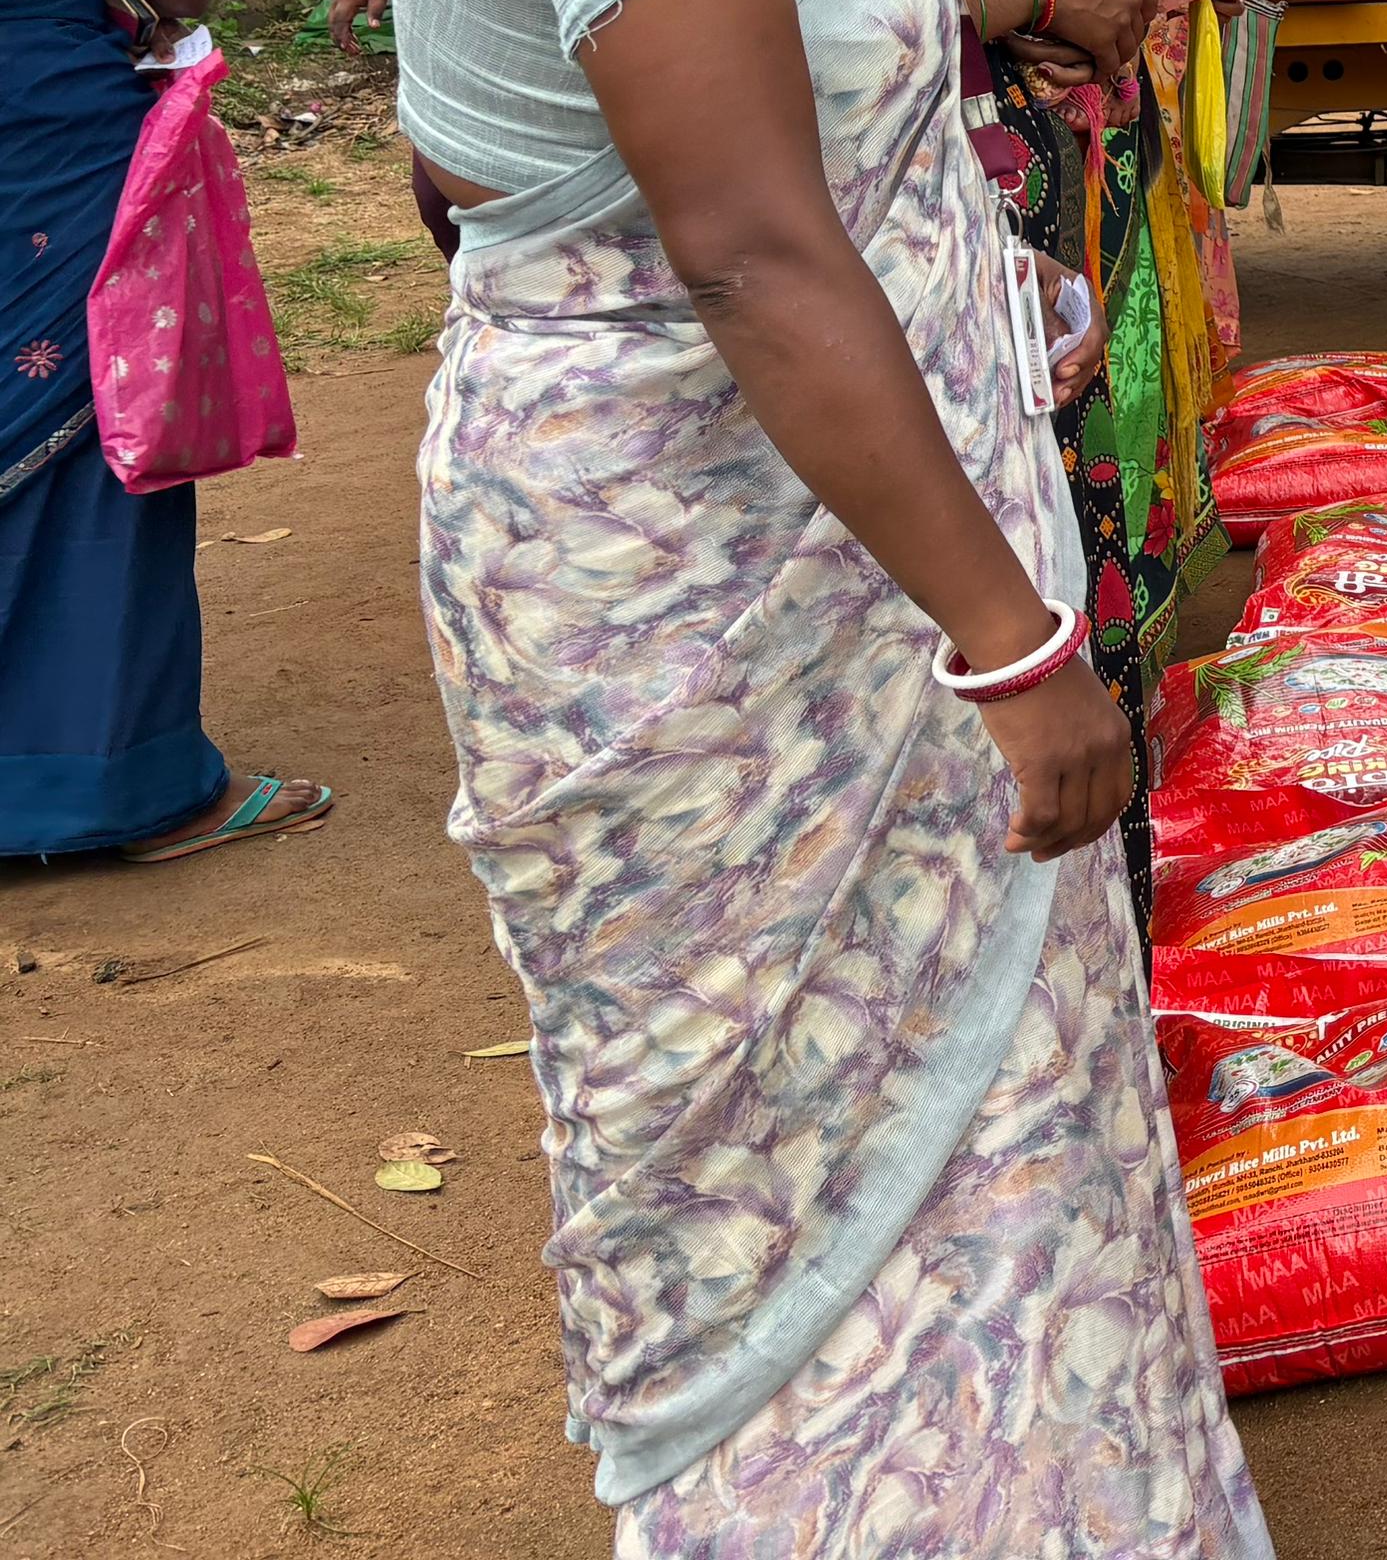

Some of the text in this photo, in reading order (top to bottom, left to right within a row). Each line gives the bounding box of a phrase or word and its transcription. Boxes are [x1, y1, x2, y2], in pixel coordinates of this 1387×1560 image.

[1250, 792, 1289, 812] MAA
[1313, 902, 1340, 917] Ltd.
[1187, 970, 1232, 989] MAA
[1228, 1156, 1260, 1176] Rice
[1261, 1144, 1297, 1165] Mills
[1299, 1137, 1329, 1153] Pvt.
[1330, 1126, 1361, 1145] Ltd.
[1304, 1271, 1360, 1308] MAA
[1219, 1305, 1277, 1338] MAA
